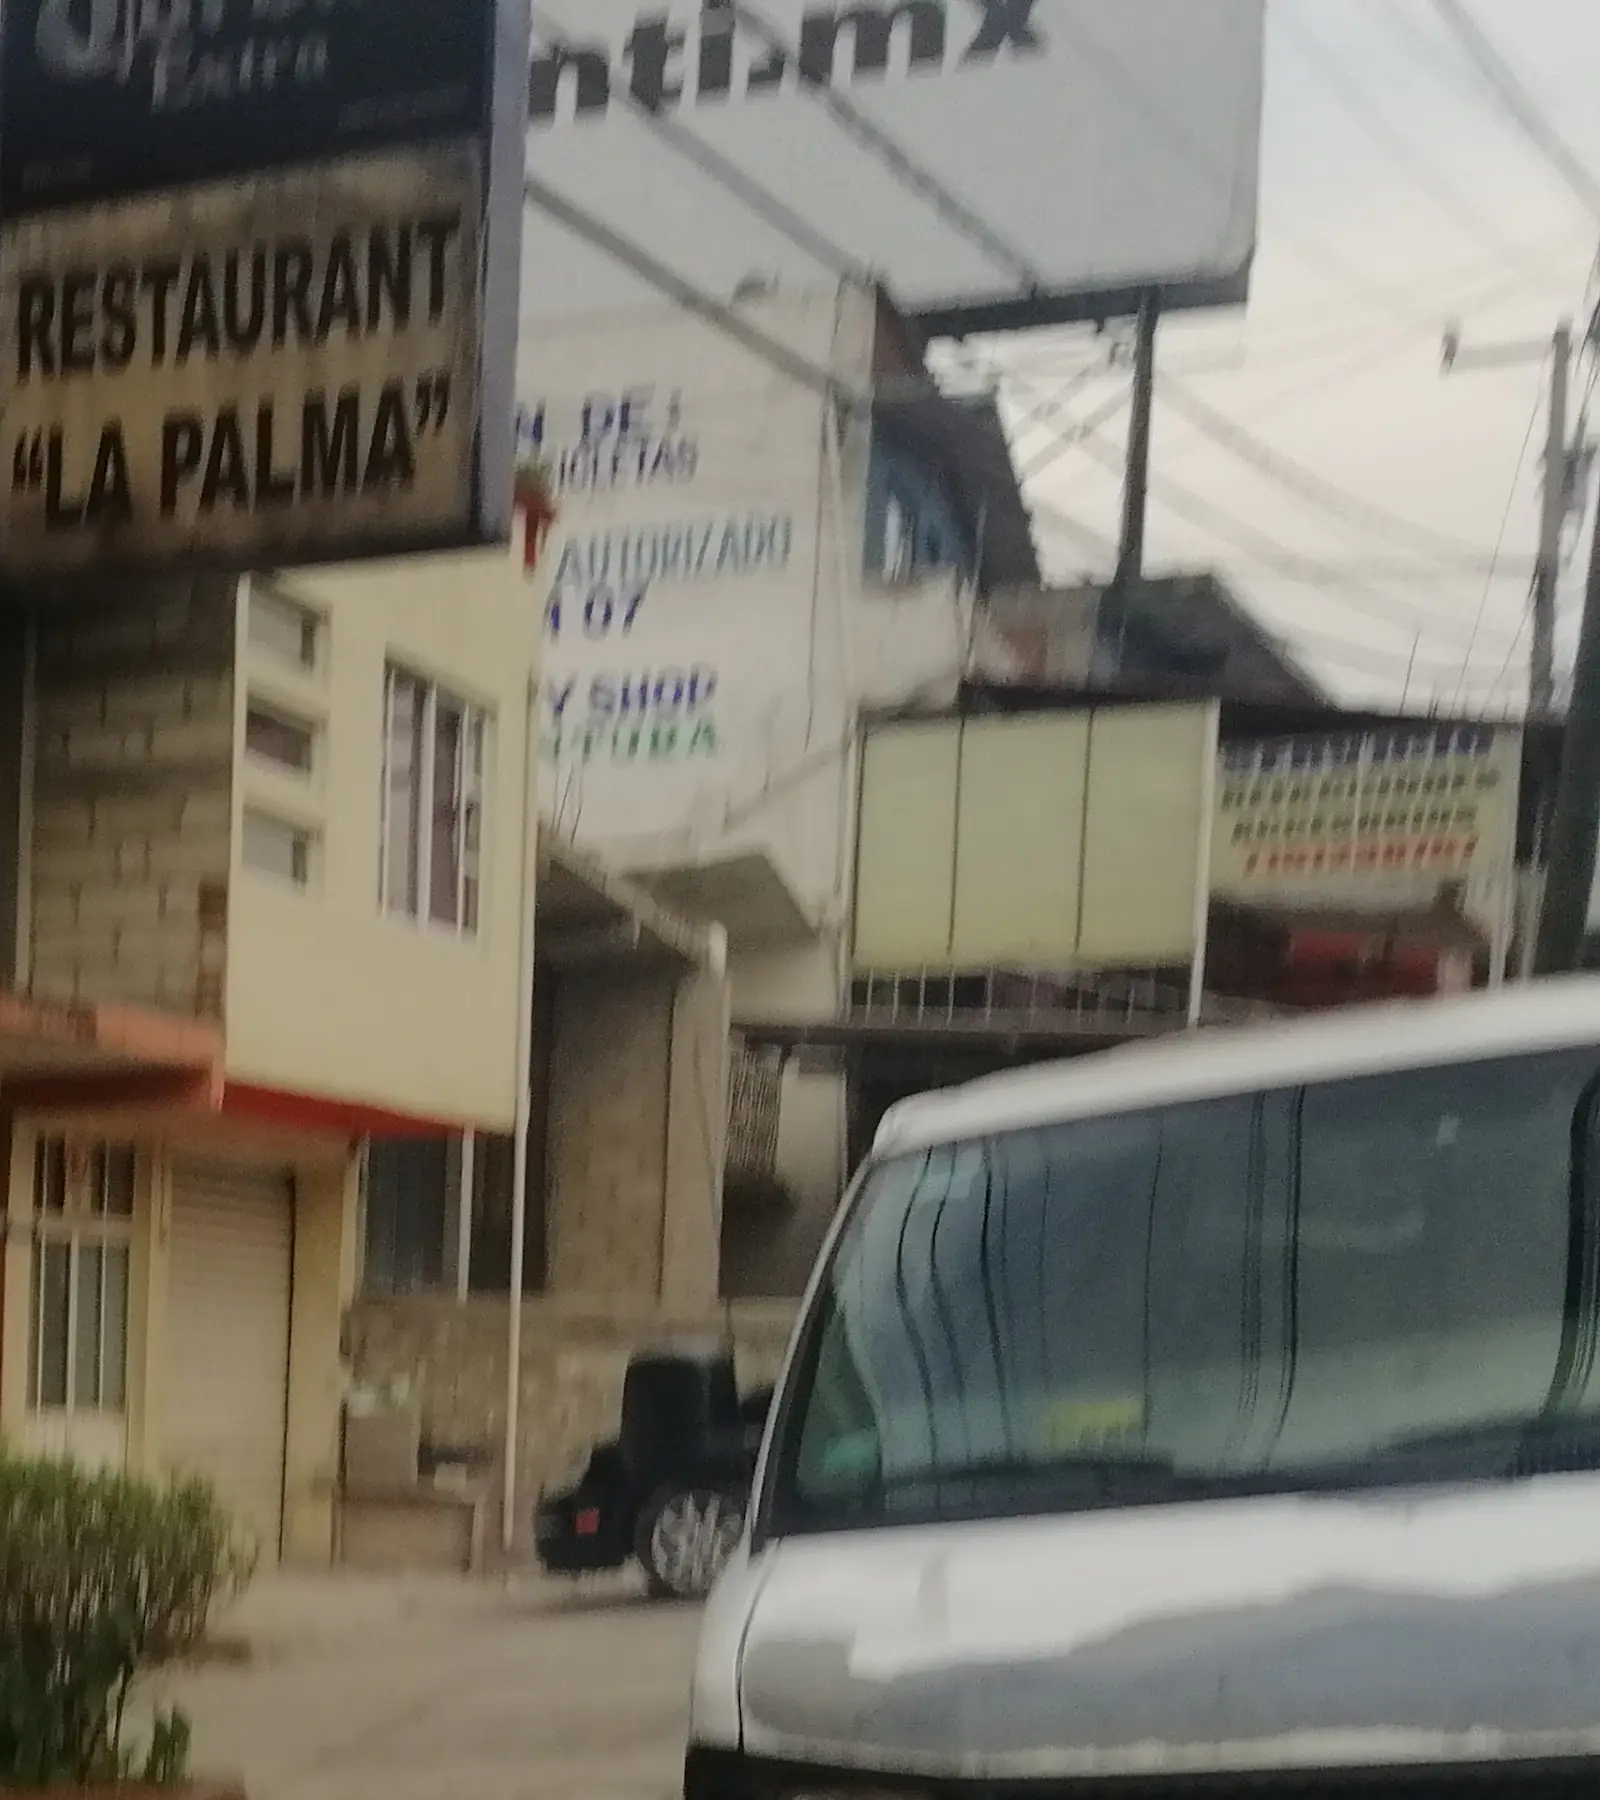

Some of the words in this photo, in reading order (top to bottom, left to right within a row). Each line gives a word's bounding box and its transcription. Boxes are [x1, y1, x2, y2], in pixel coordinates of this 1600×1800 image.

[17, 205, 461, 384] RESTAURANT
[555, 508, 793, 590] AUTORIZADO
[588, 662, 719, 720] SHOP
